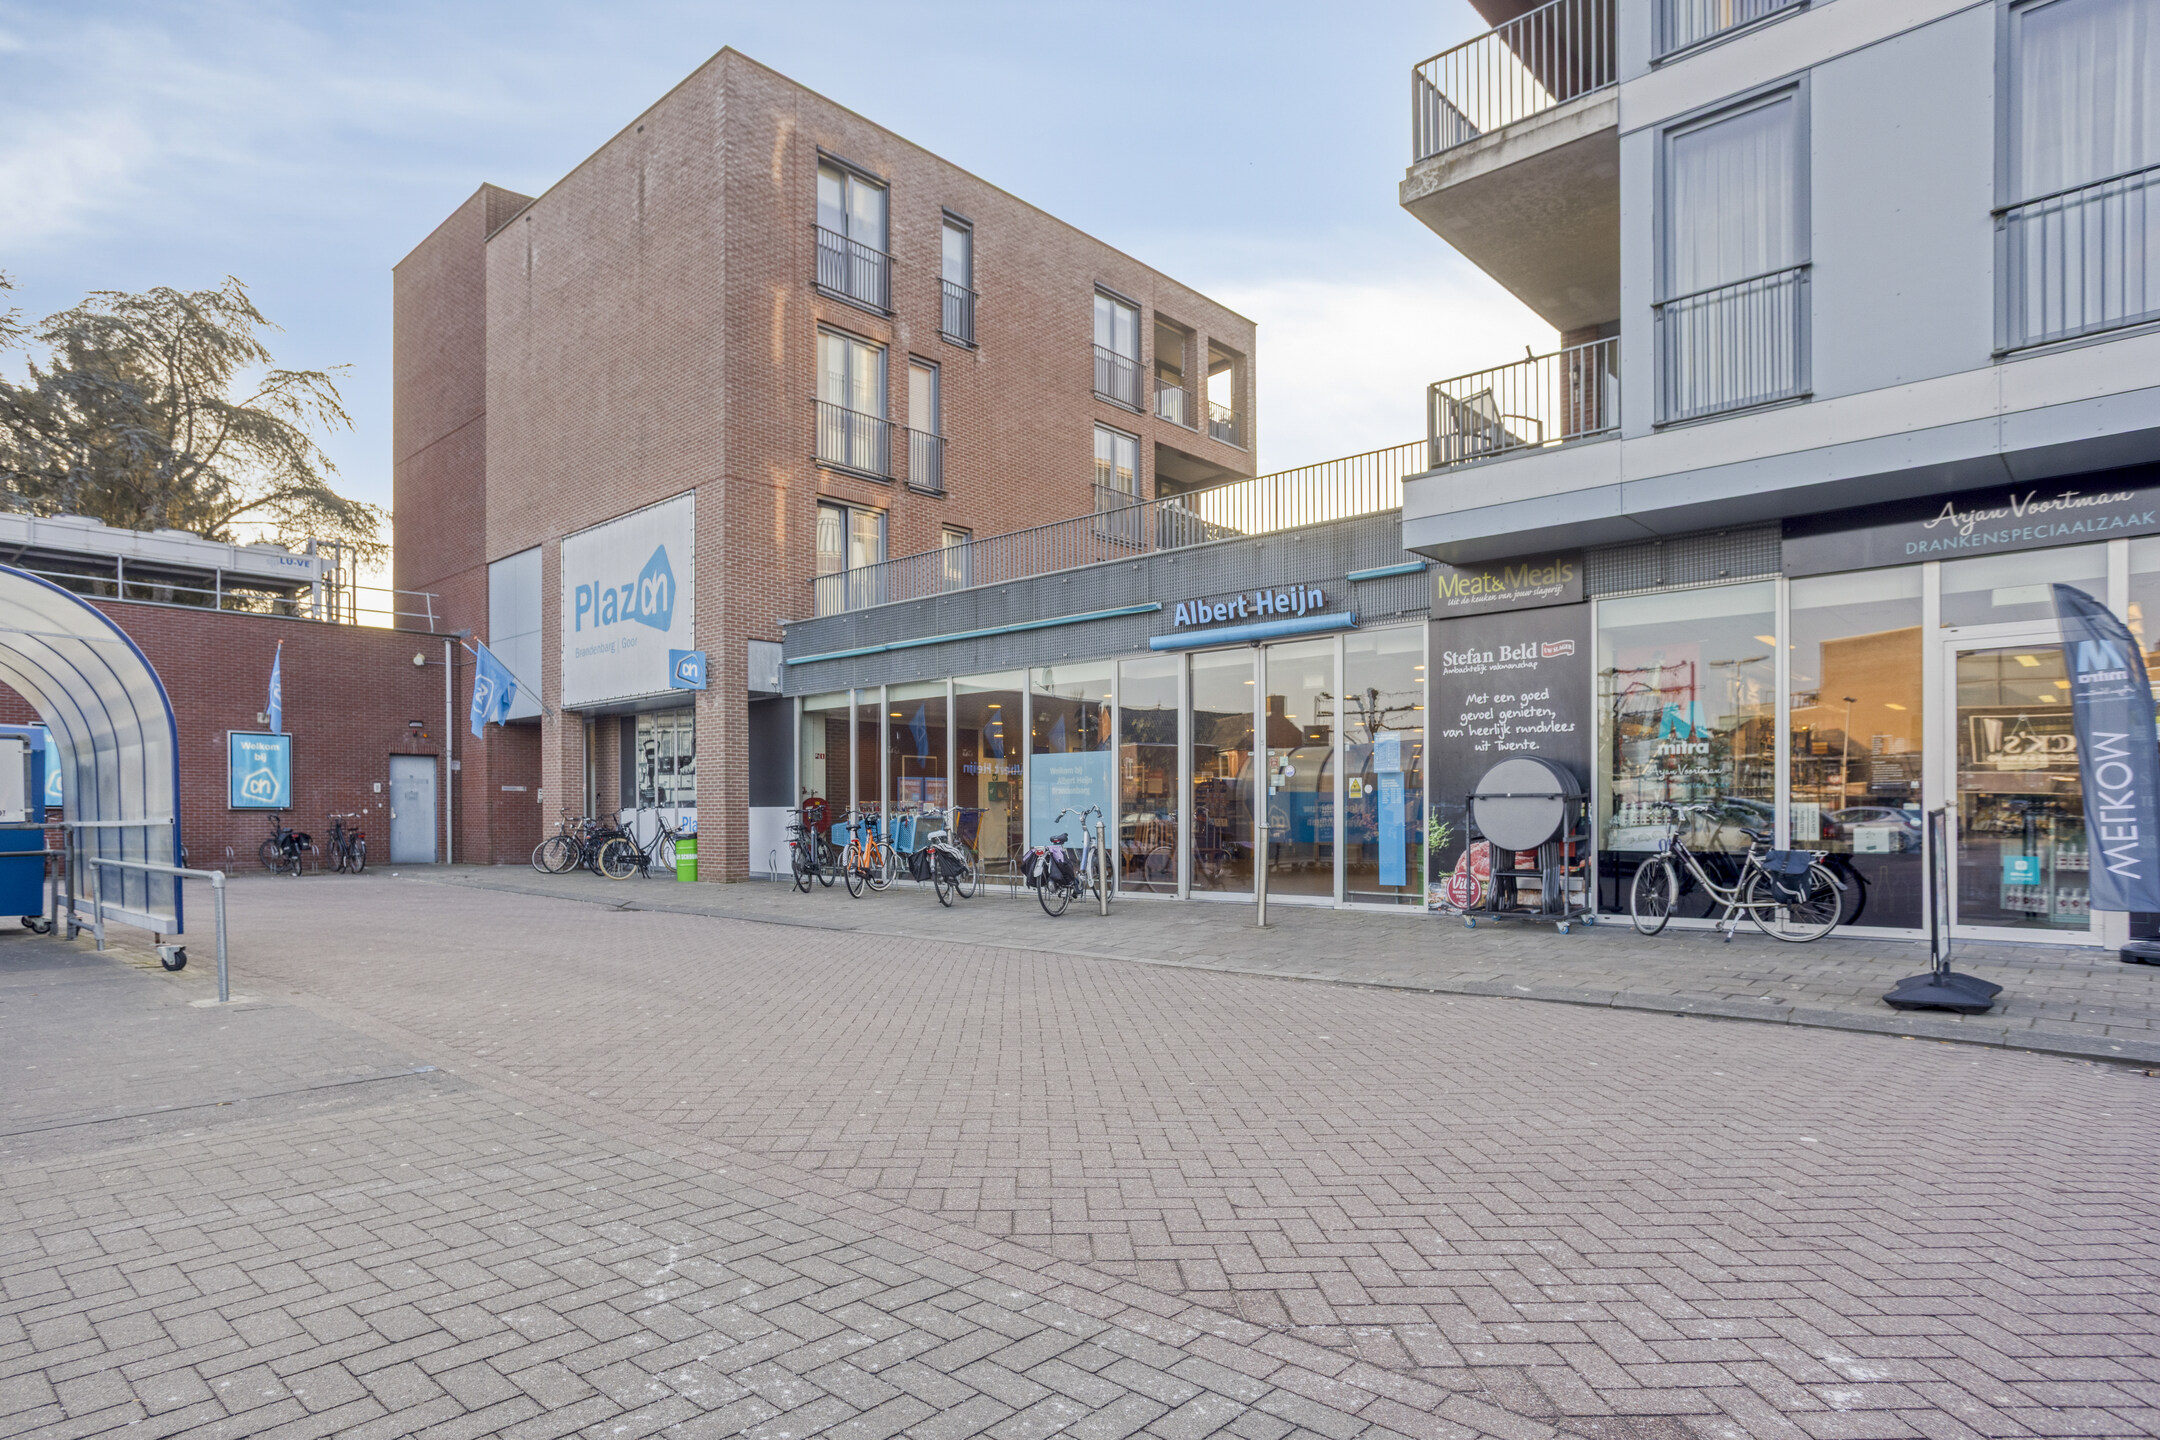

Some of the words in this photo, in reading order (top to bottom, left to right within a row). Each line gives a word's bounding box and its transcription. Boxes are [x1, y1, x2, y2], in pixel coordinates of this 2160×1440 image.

[2010, 490, 2135, 518] Voortman
[1905, 511, 2156, 555] DRANKENSPECIAALZAAK
[1174, 594, 1248, 627] Albert
[1256, 585, 1325, 617] Heijn
[1460, 595, 1470, 604] de
[1471, 593, 1498, 603] keuken
[1498, 591, 1512, 600] van
[1512, 589, 1532, 601] jouw
[575, 641, 616, 659] Brandenbarg
[621, 637, 638, 649] Goor
[1443, 648, 1494, 667] Stefan
[1499, 642, 1538, 661] Beld
[1442, 663, 1488, 675] Ambachtelijk
[1489, 660, 1538, 670] vakmanschap
[1465, 692, 1489, 706] Met
[1494, 694, 1516, 704] een
[1520, 688, 1550, 707] goed
[1460, 707, 1494, 726] gevoel
[1499, 706, 1556, 724] genieten,
[1443, 729, 1464, 738] van
[1468, 723, 1511, 740] heerlijk
[1515, 720, 1575, 734] rundvlees
[240, 740, 280, 752] Welkom
[1474, 740, 1491, 752] uit
[1494, 739, 1540, 752] Twente.
[1658, 741, 1710, 755] mitra
[254, 752, 267, 763] bij
